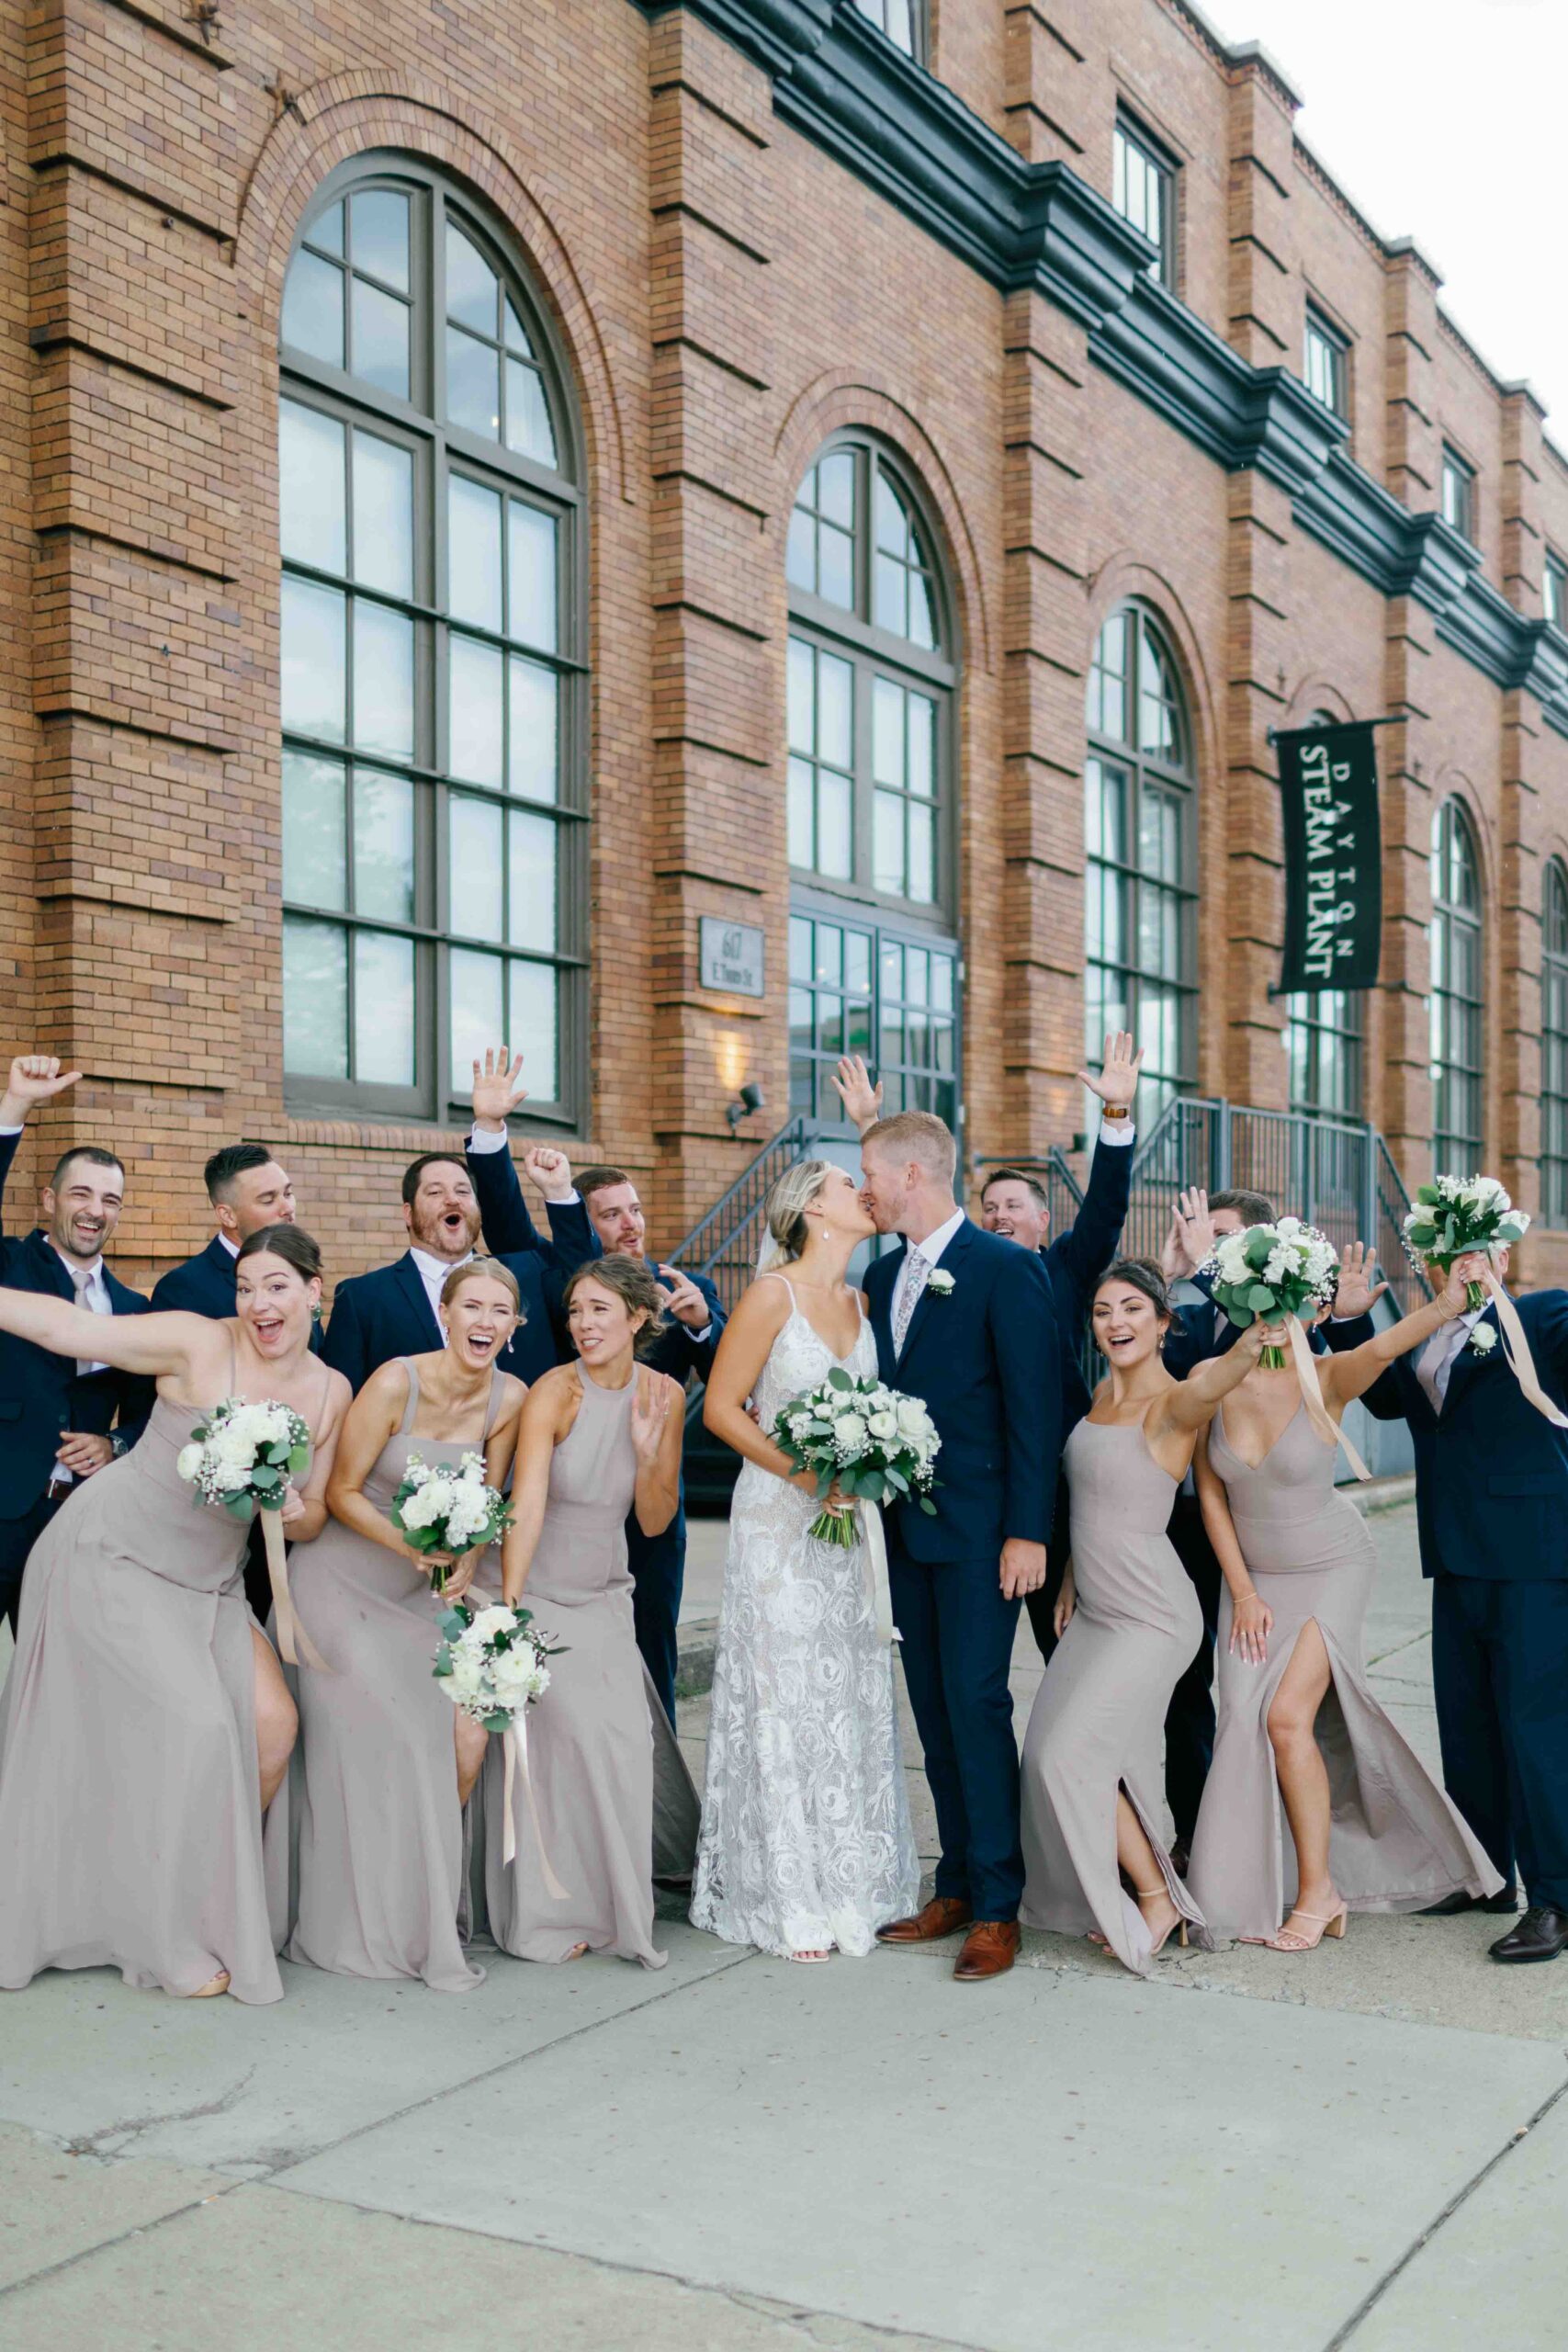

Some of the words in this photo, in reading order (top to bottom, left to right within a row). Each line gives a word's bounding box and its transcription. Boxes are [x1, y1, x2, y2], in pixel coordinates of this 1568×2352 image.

[1300, 744, 1335, 862] STEAM
[1332, 763, 1356, 957] DAYTON
[1304, 868, 1335, 979] PLANT
